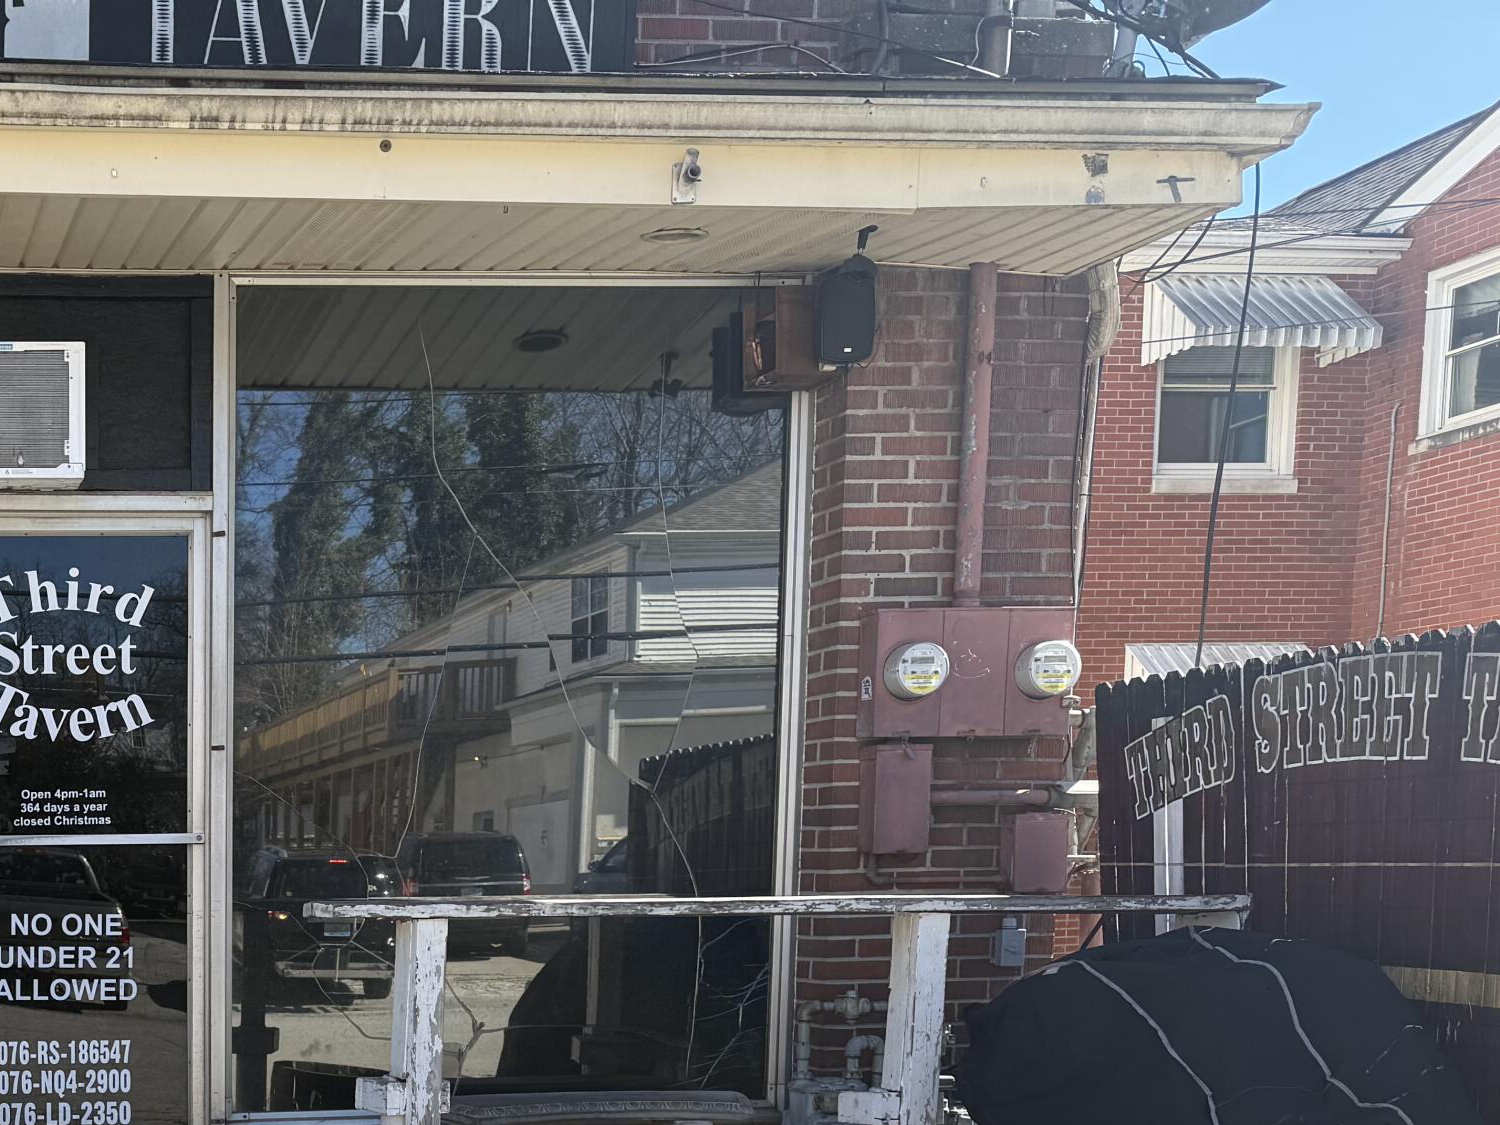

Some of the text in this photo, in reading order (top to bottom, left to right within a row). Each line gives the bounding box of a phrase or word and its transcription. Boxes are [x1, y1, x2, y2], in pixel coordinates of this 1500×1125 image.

[1124, 694, 1235, 820] THIRD
[1252, 651, 1443, 774] STREET
[21, 788, 106, 801] Open 4pm-1am
[20, 803, 108, 814] 364 days a year
[13, 815, 112, 826] closed Christmas
[10, 913, 123, 936] NO ONE
[106, 946, 134, 968] 21
